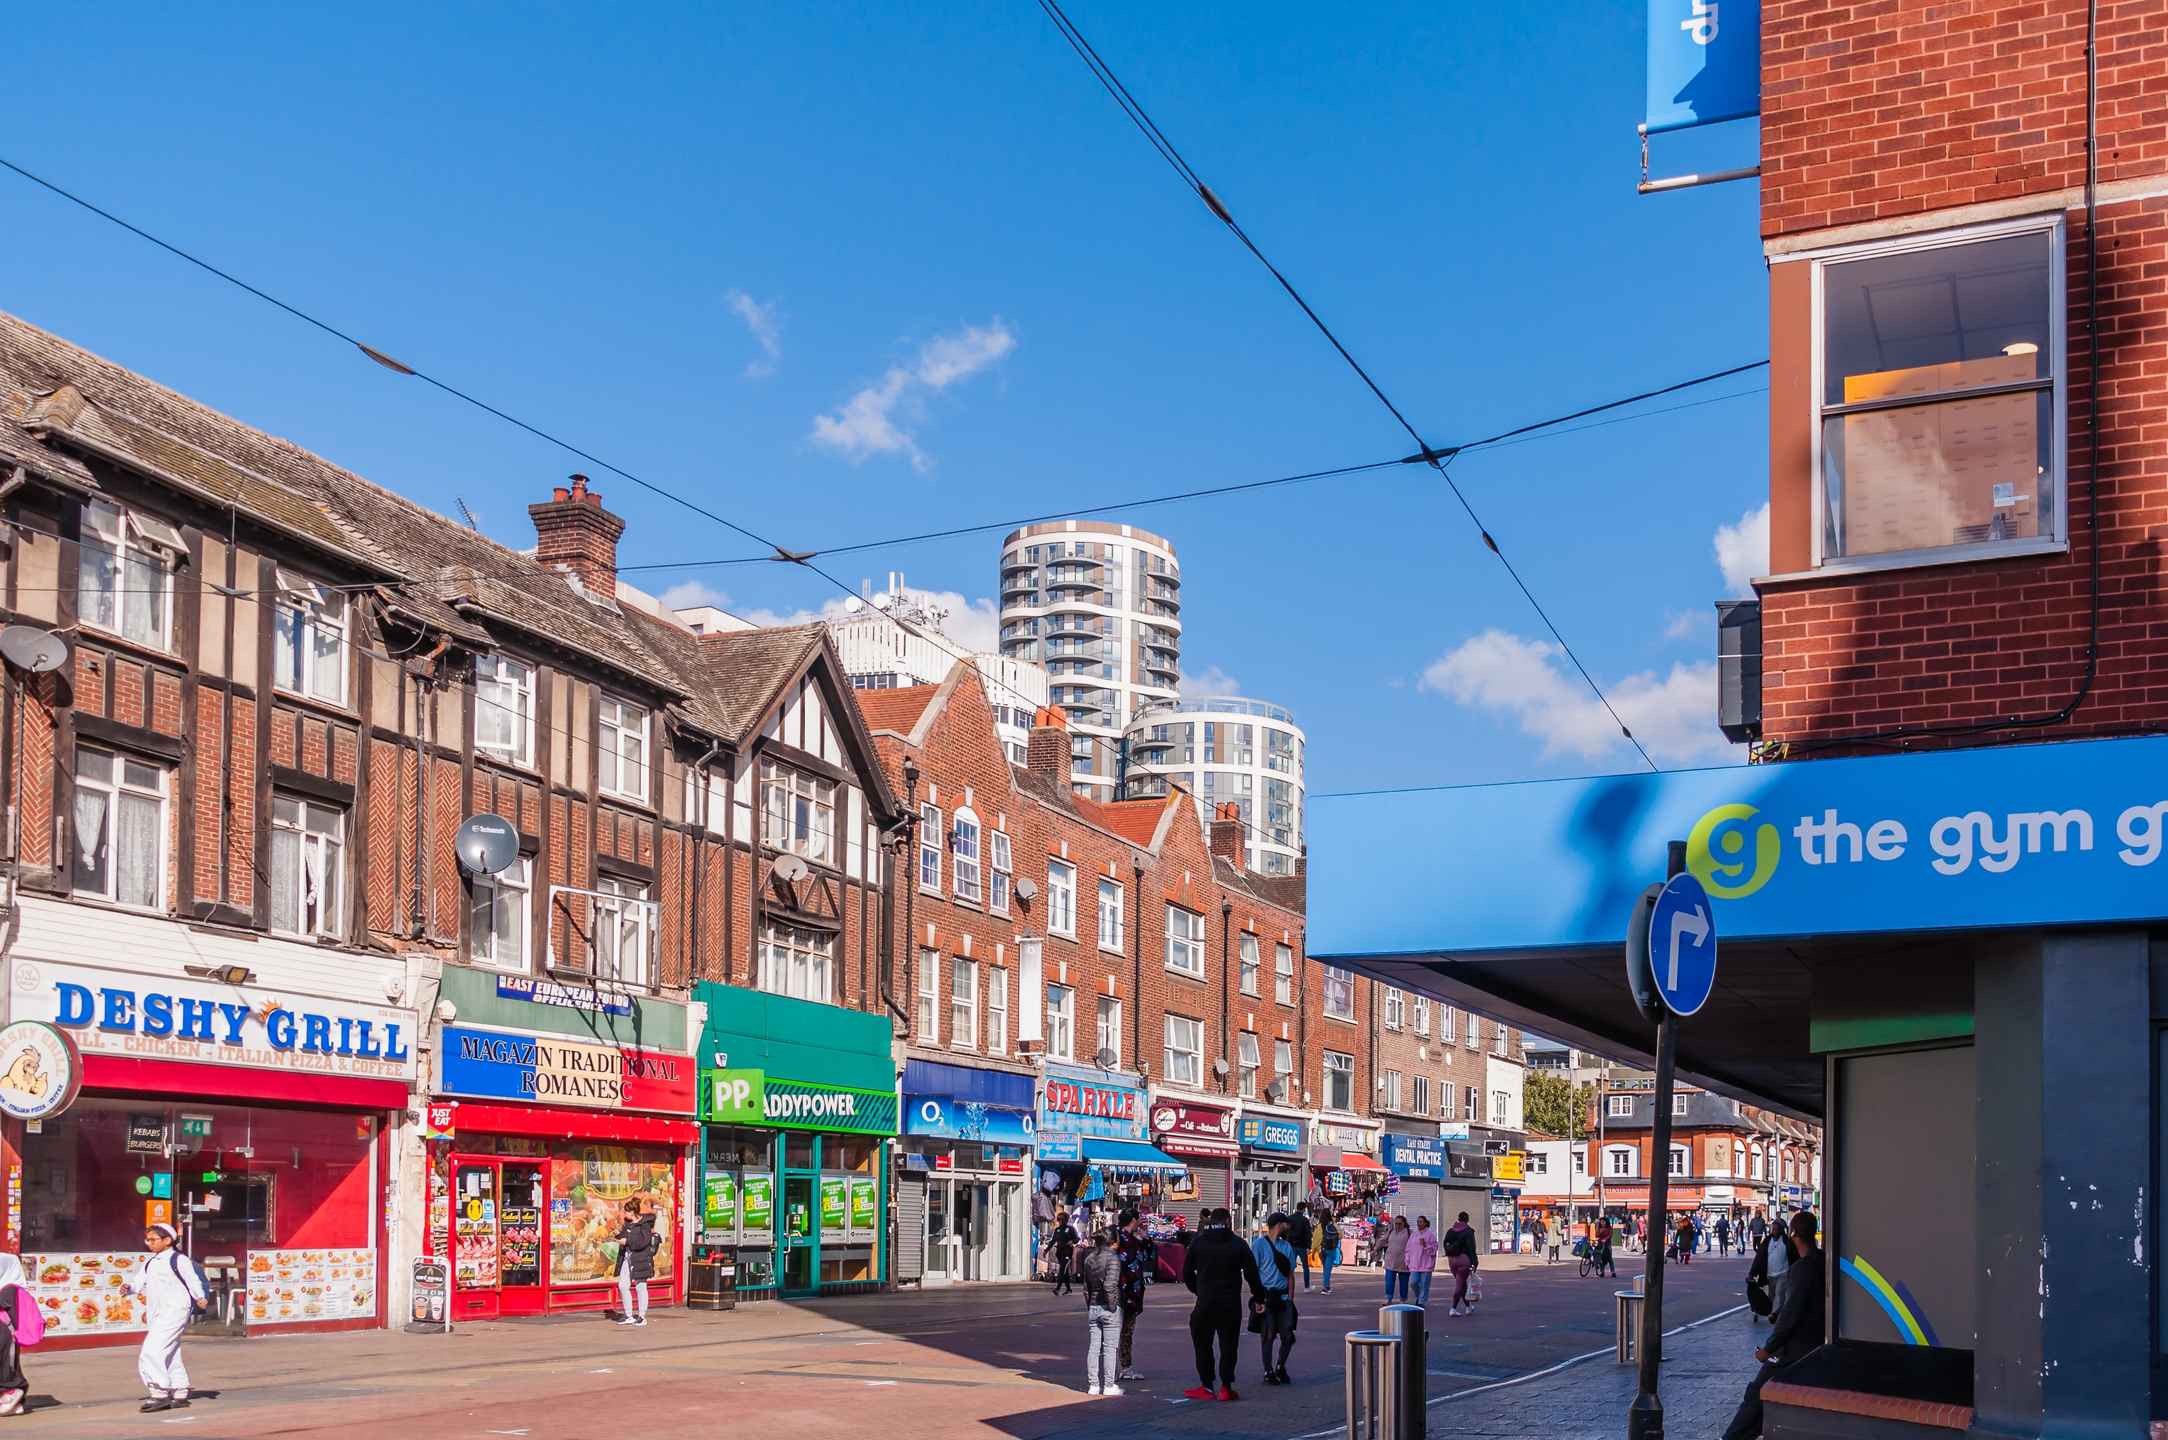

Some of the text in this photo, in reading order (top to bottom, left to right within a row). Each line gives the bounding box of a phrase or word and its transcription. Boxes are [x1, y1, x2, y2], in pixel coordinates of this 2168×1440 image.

[1793, 808, 1908, 865] the
[1929, 808, 2094, 876] gym
[507, 977, 534, 992] EAST
[535, 982, 594, 1001] EUROPEAN
[55, 981, 410, 1061] DESHY GRILL
[73, 1030, 402, 1076] ILL CHICKEN ITALIAN PIZZA & COFFEE
[460, 1036, 679, 1081] MAGAZIN TRADITIONAL
[521, 1071, 633, 1101] ROMANESC
[1046, 1079, 1136, 1120] SPARKLE
[431, 1107, 451, 1119] JUST
[434, 1116, 452, 1126] EAT
[921, 1101, 944, 1126] O2
[133, 1127, 160, 1138] KEBABS
[1265, 1126, 1298, 1146] GREGGS
[1395, 1148, 1442, 1166] DENTAL PRACTICE
